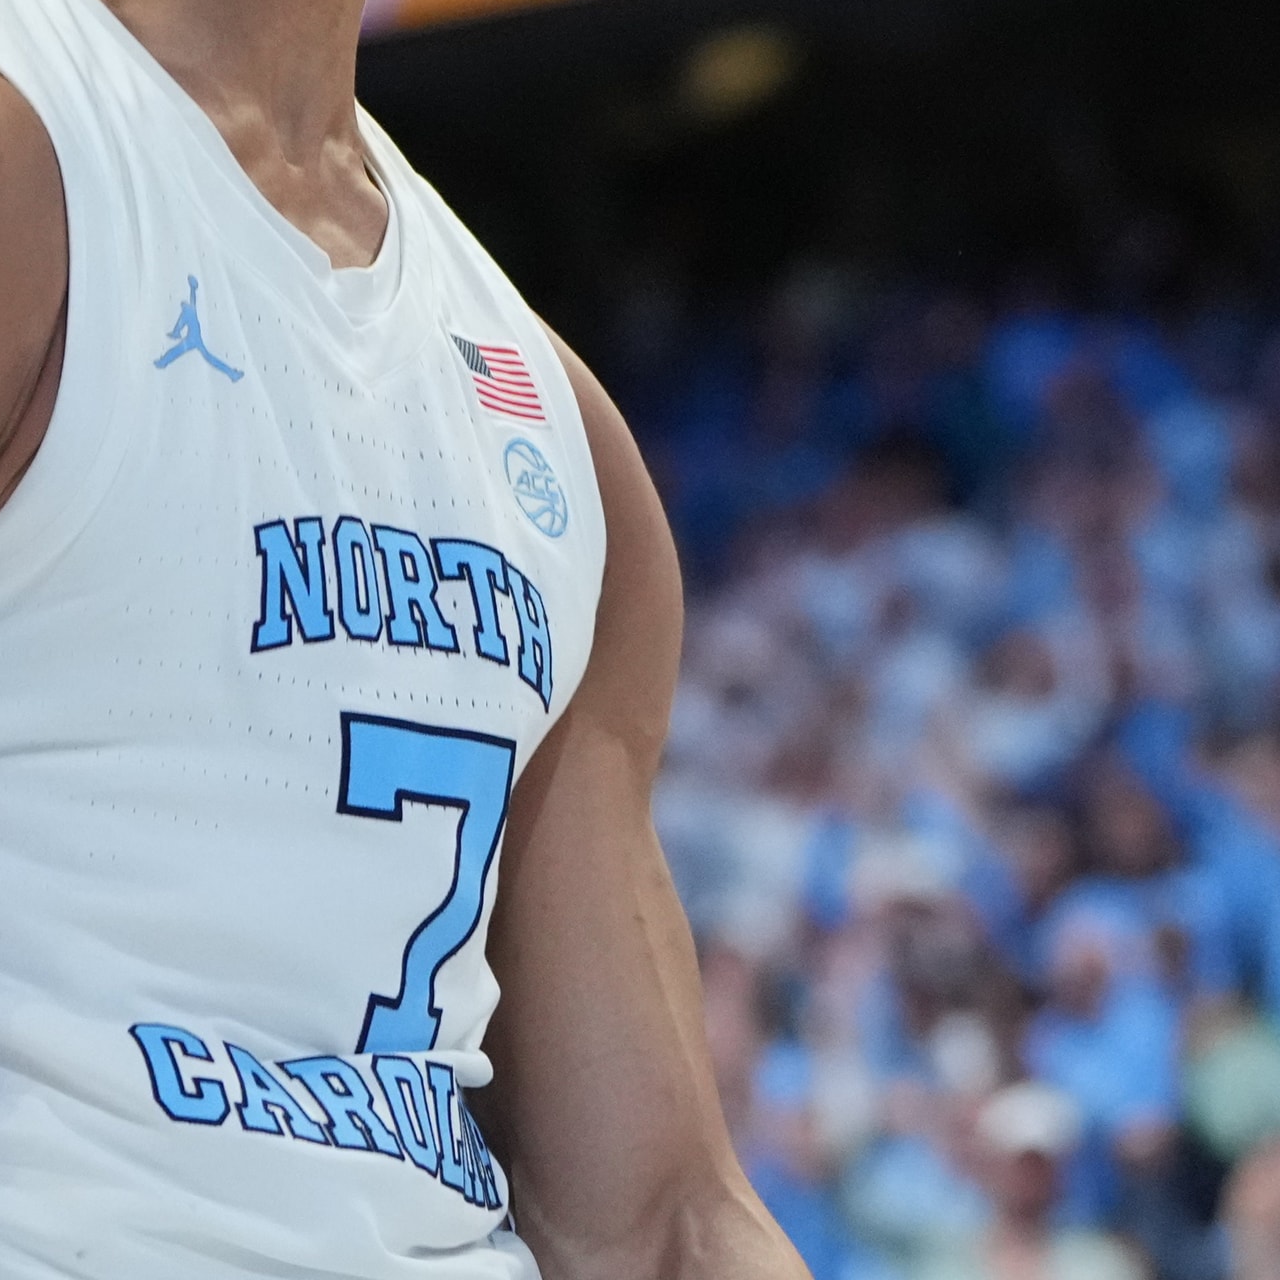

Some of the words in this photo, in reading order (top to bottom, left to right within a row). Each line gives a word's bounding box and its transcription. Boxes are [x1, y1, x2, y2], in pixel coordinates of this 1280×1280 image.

[515, 469, 559, 498] ACC
[251, 516, 553, 713] NORTH
[337, 712, 517, 1054] 7
